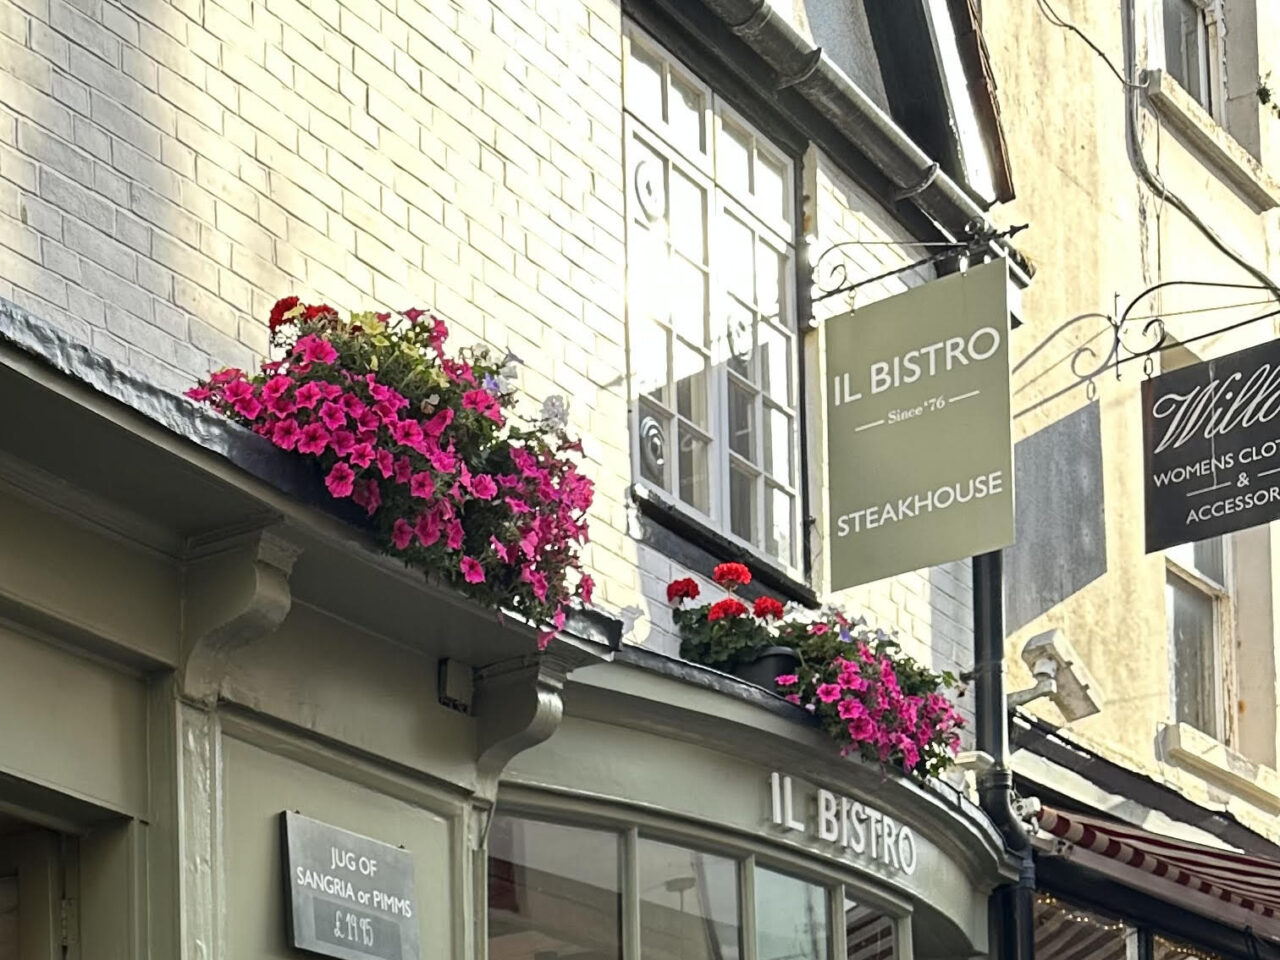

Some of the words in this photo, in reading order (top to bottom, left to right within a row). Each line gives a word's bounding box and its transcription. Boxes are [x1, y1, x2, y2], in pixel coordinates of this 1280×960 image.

[834, 372, 862, 407] IL
[870, 327, 1001, 395] BISTRO
[887, 405, 923, 424] Since
[1153, 453, 1234, 488] WOMENS
[1236, 472, 1250, 487] &
[837, 471, 1003, 537] STEAKHOUSE
[1186, 486, 1280, 525] ACCESSOR
[771, 772, 805, 832] IL
[817, 788, 917, 876] BISTRO
[331, 847, 356, 871] JUG
[359, 857, 377, 877] OF
[297, 866, 355, 901] SANGRIA
[357, 891, 371, 905] or
[373, 890, 412, 918] PIMMS
